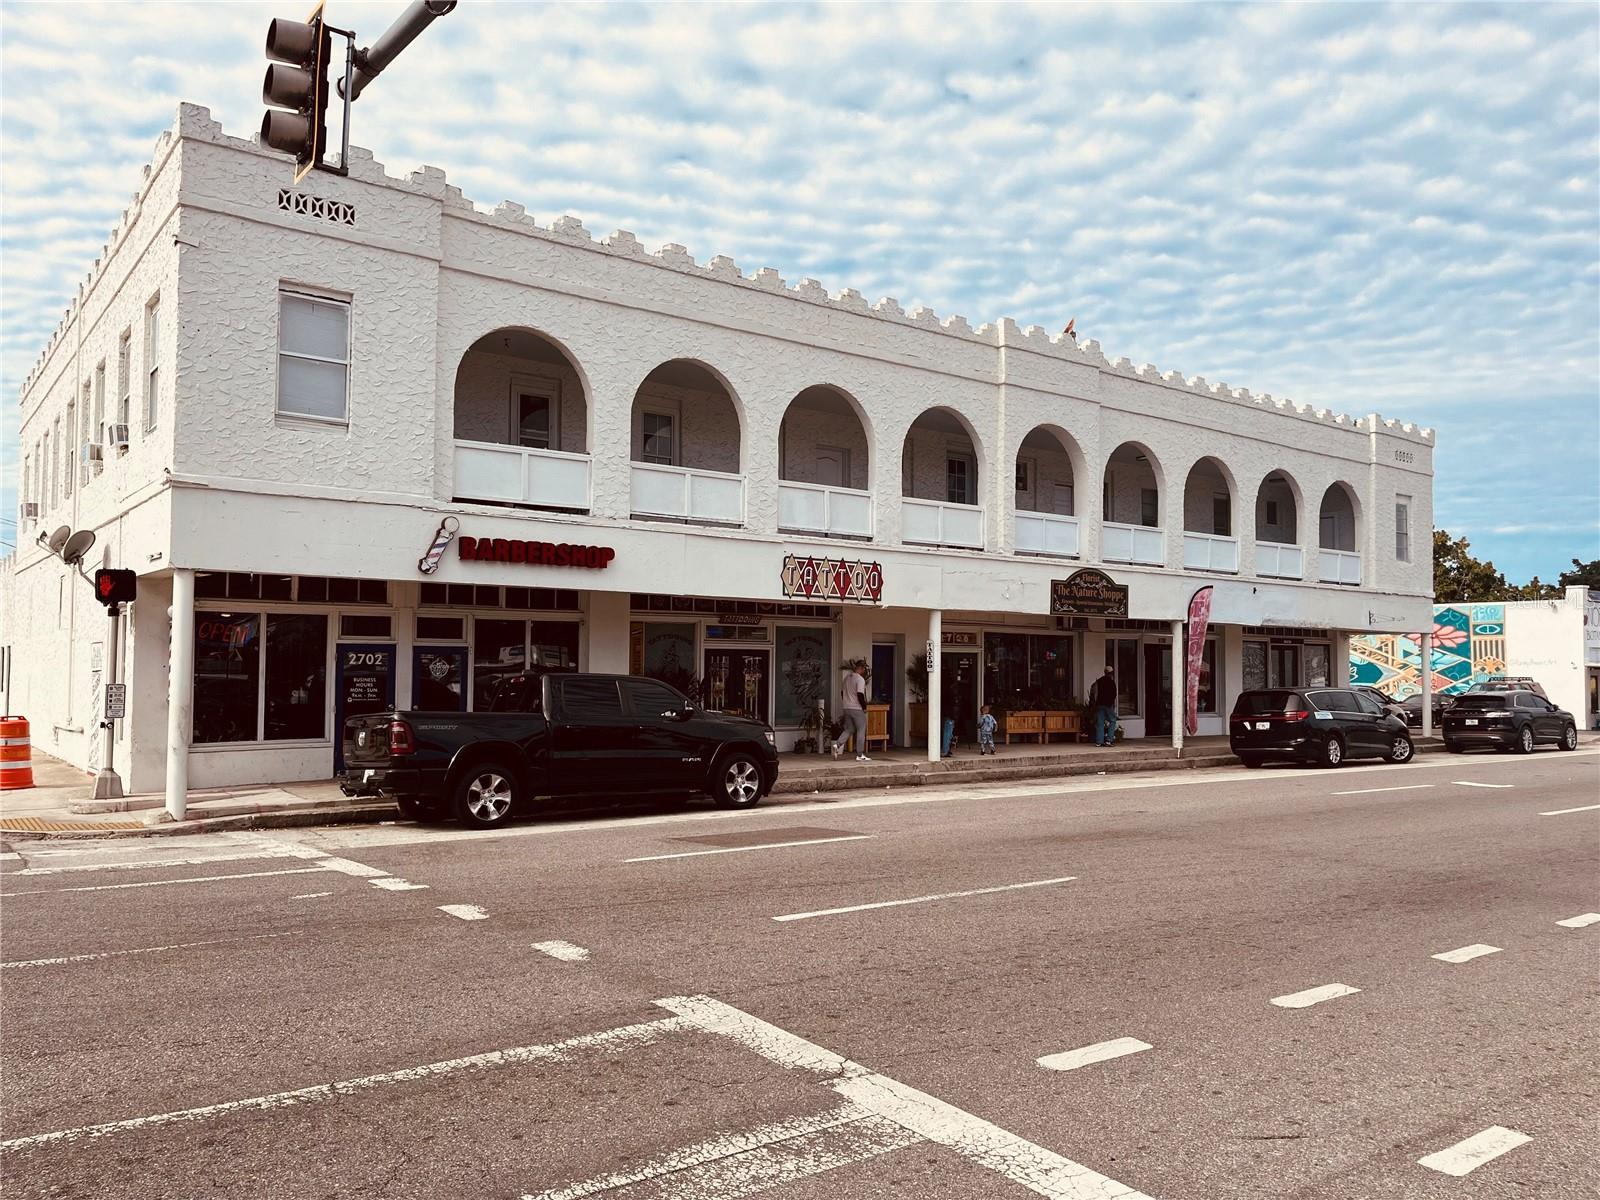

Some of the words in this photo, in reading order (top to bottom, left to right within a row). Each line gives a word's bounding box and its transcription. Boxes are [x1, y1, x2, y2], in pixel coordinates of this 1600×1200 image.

[458, 536, 616, 569] BARBERSHOP
[785, 564, 879, 590] TATTOO
[1082, 573, 1100, 583] Florist
[1056, 584, 1070, 596] The
[1072, 586, 1098, 598] Nature
[1098, 588, 1124, 602] Shoppe
[199, 622, 249, 647] OPEN
[348, 653, 383, 665] 2702
